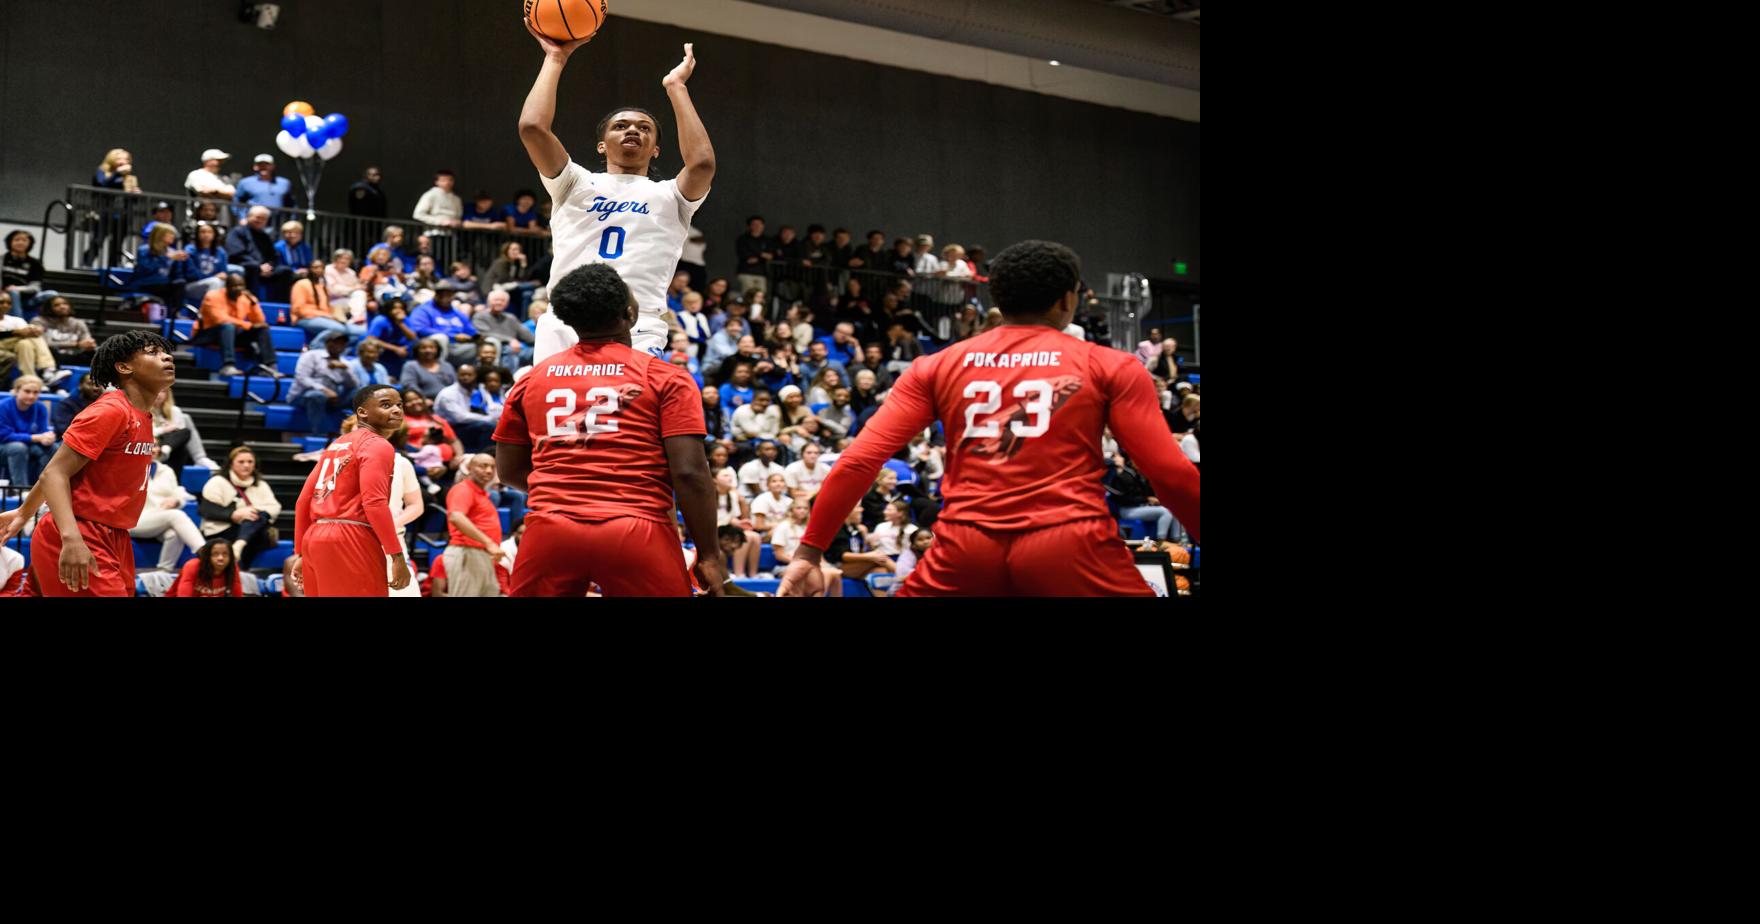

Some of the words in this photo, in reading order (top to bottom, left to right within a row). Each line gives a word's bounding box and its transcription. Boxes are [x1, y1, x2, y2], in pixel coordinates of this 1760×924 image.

[587, 196, 650, 221] Tigers
[598, 226, 626, 259] 0
[546, 363, 625, 377] POKAPRIDE
[962, 351, 1062, 369] POKAPRIDE
[546, 387, 619, 437] 22
[963, 380, 1054, 437] 23
